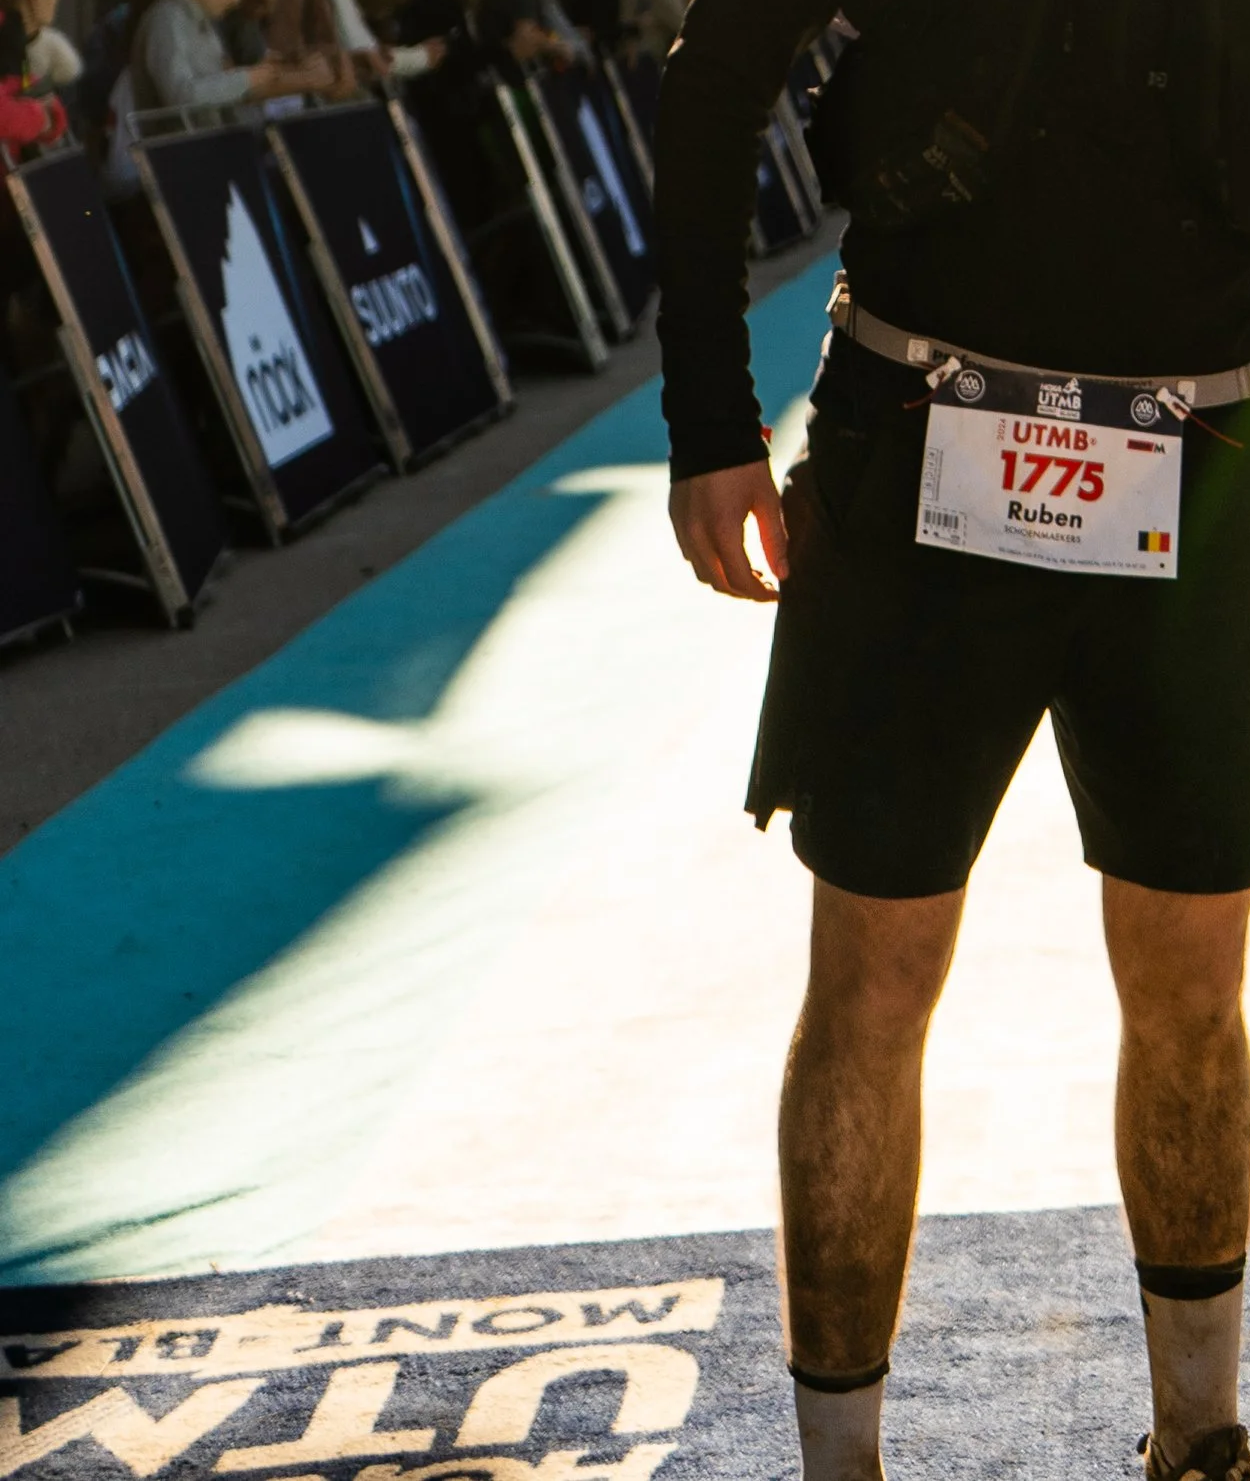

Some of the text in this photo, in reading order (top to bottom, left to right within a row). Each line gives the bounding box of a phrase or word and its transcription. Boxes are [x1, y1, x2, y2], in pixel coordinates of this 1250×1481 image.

[351, 262, 438, 347] SUUNTO
[1038, 391, 1082, 410] UTMB
[1000, 449, 1106, 503] 1775
[1007, 500, 1083, 530] Ruben
